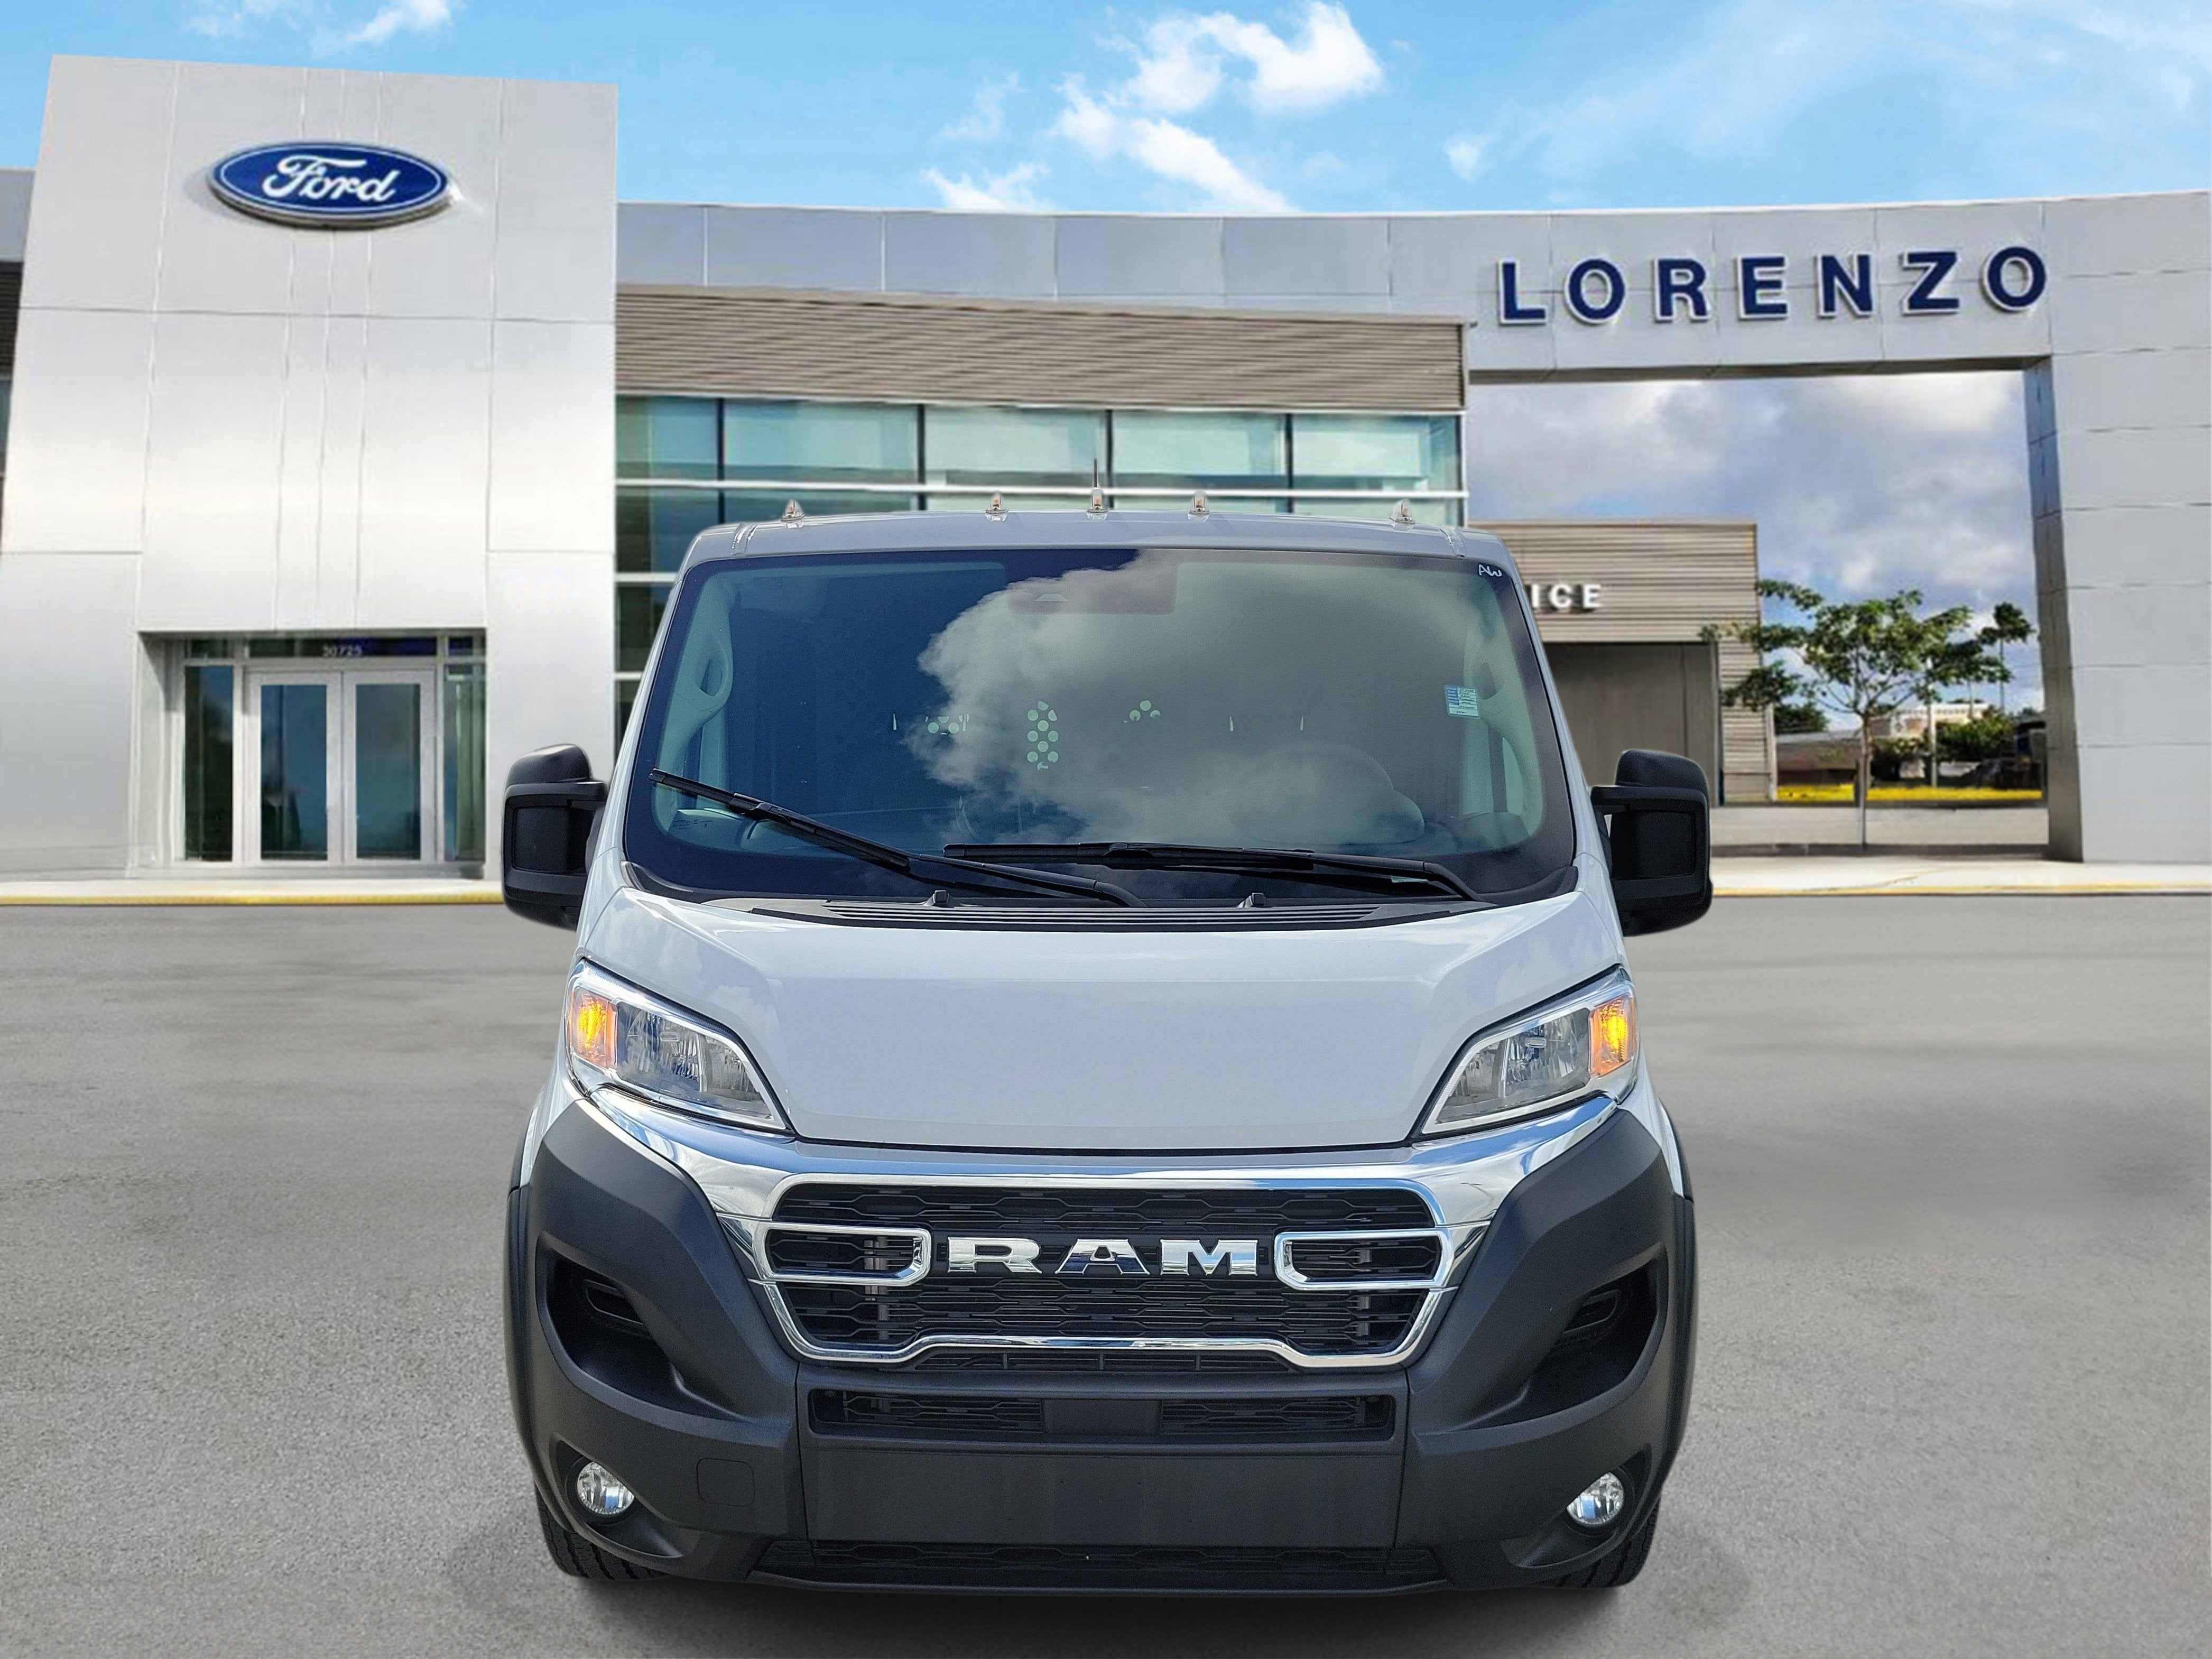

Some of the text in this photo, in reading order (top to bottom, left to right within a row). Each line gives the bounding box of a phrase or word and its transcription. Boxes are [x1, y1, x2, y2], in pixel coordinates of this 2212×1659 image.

[262, 155, 400, 201] Ford
[1498, 246, 2047, 326] LORENZO
[948, 1237, 1258, 1276] RAM
